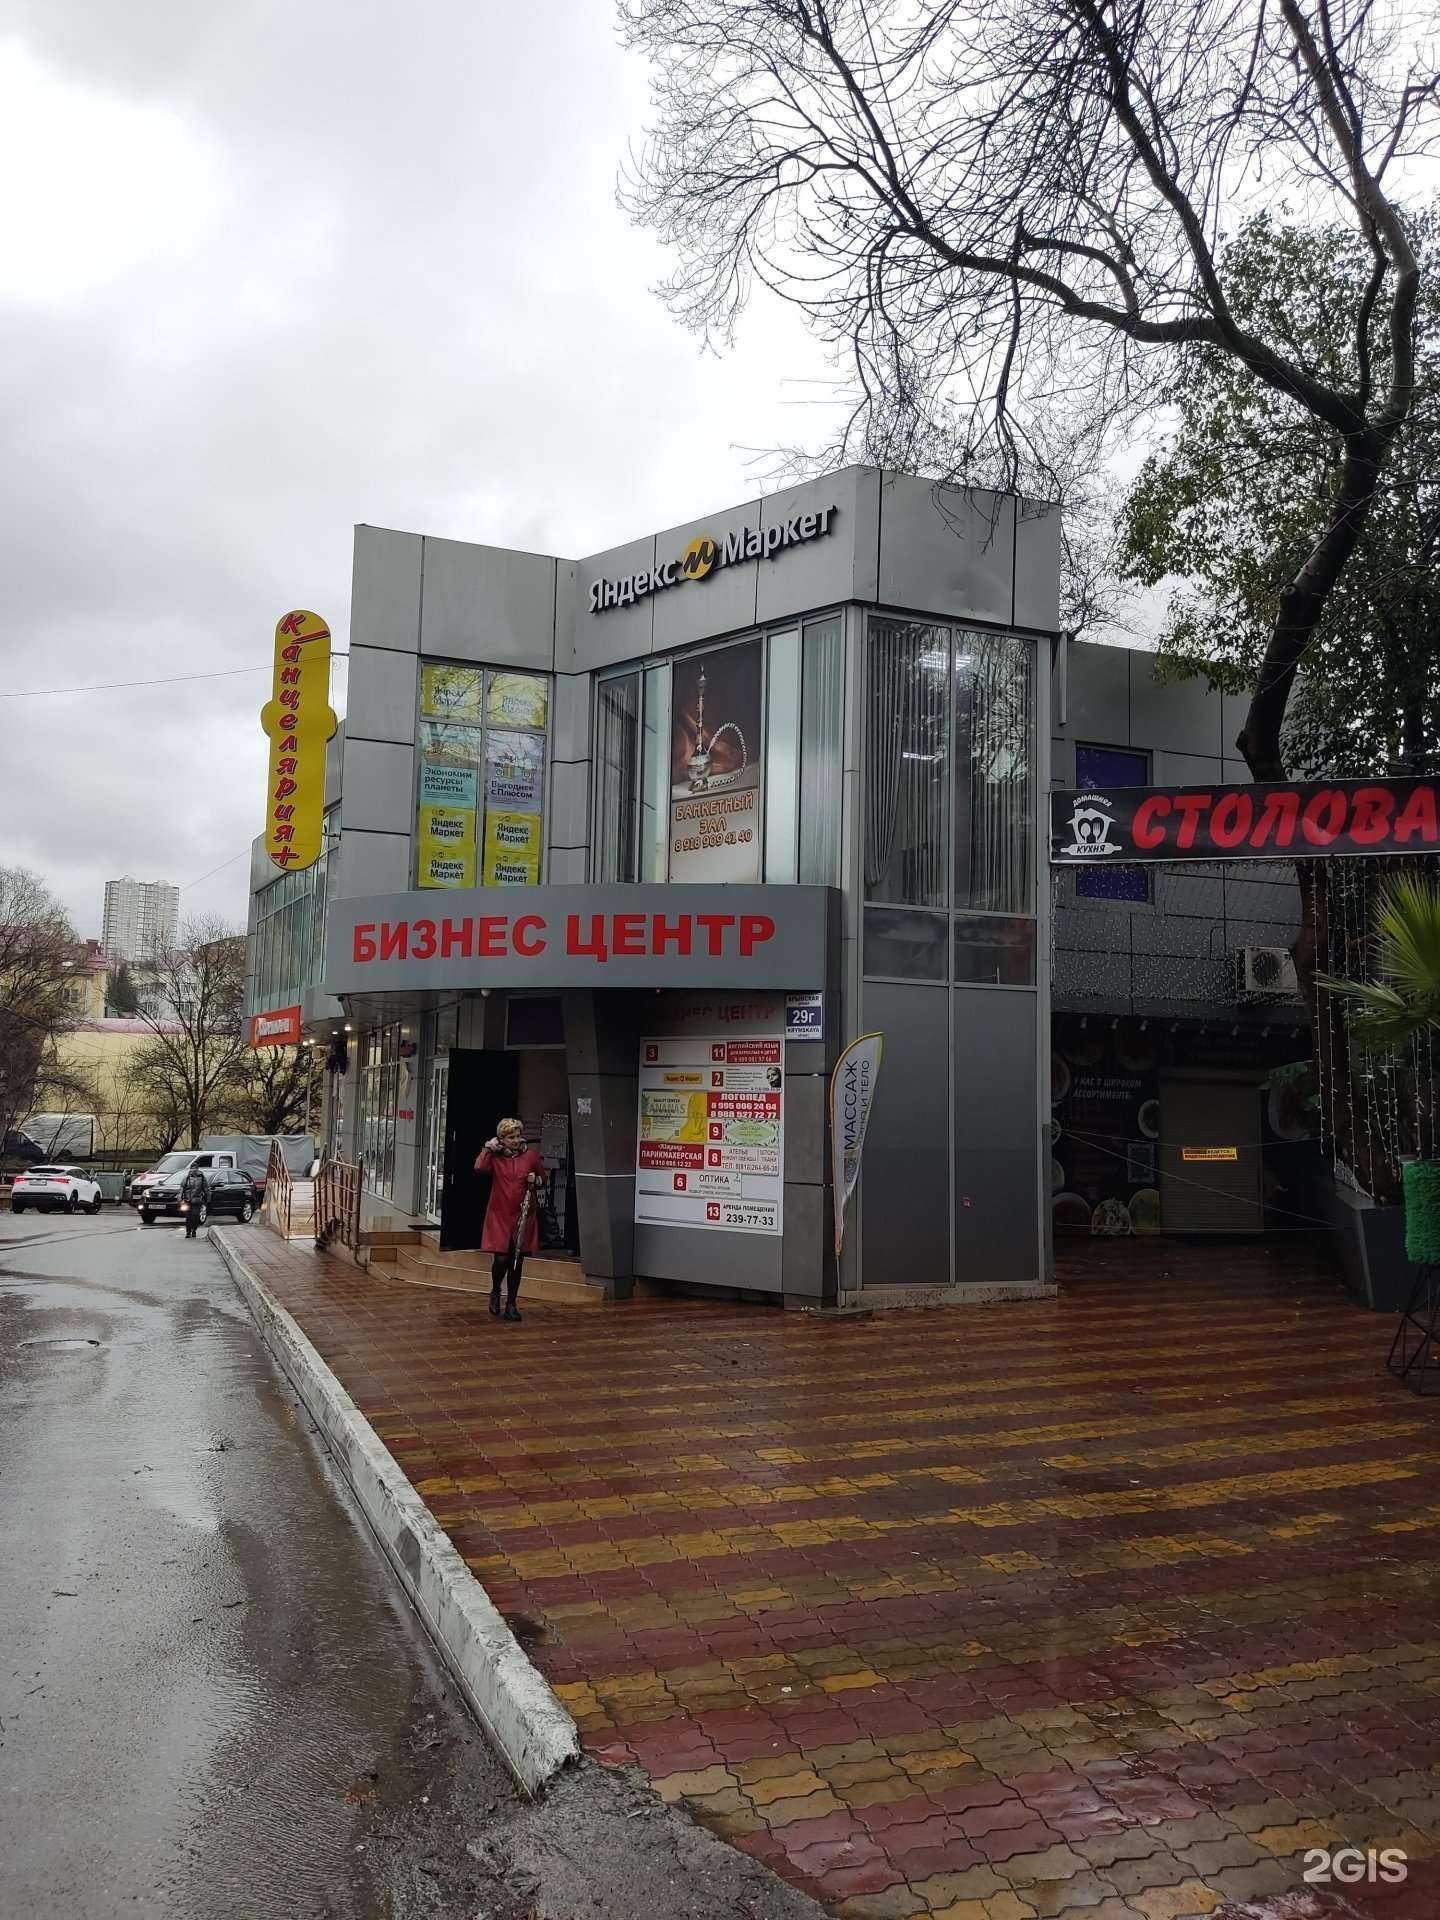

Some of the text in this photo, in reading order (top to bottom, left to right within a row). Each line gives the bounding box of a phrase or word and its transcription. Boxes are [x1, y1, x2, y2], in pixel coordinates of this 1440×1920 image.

[588, 558, 678, 614] Яндекс
[720, 504, 837, 568] Маркет
[424, 767, 472, 779] Экономим
[424, 776, 463, 788] ресурсы
[424, 783, 463, 793] планеты
[497, 788, 533, 799] Плюсом
[1072, 793, 1113, 808] ДОМАШНЯЯ
[675, 792, 754, 821] БАНКЕТНЫЙ
[431, 817, 464, 829] Яндекс
[1131, 786, 1440, 850] СТОЛОВА
[497, 822, 529, 835] Яндекс
[699, 817, 727, 835] ЗАЛ
[430, 827, 464, 838] Маркет
[496, 832, 529, 844] Маркет
[674, 839, 682, 852] 8
[682, 837, 701, 851] 918
[702, 834, 723, 849] 909
[738, 830, 753, 843] 40
[1076, 844, 1106, 854] КУХНЯ
[431, 860, 464, 871] Яндекс
[496, 862, 527, 874] Яндекс
[430, 869, 464, 880] Маркет
[494, 872, 528, 883] Маркет
[352, 914, 776, 963] БИЗНЕС ЦЕНТР
[648, 1048, 655, 1058] 3
[714, 1048, 724, 1058] 11
[714, 1072, 722, 1085] 2
[861, 1060, 870, 1095] ТЕЛО
[721, 1093, 766, 1102] ЛОГОПЕД
[649, 1103, 686, 1114] ANANAS
[844, 1060, 858, 1150] МАССАЖ
[712, 1127, 719, 1138] 9
[642, 1150, 702, 1160] ПАРИКМАХЕРСКАЯ
[712, 1153, 718, 1163] 8
[677, 1178, 684, 1187] 6
[699, 1174, 730, 1184] ОПТИКА
[708, 1207, 720, 1217] 13
[726, 1214, 774, 1226] 239-77-33
